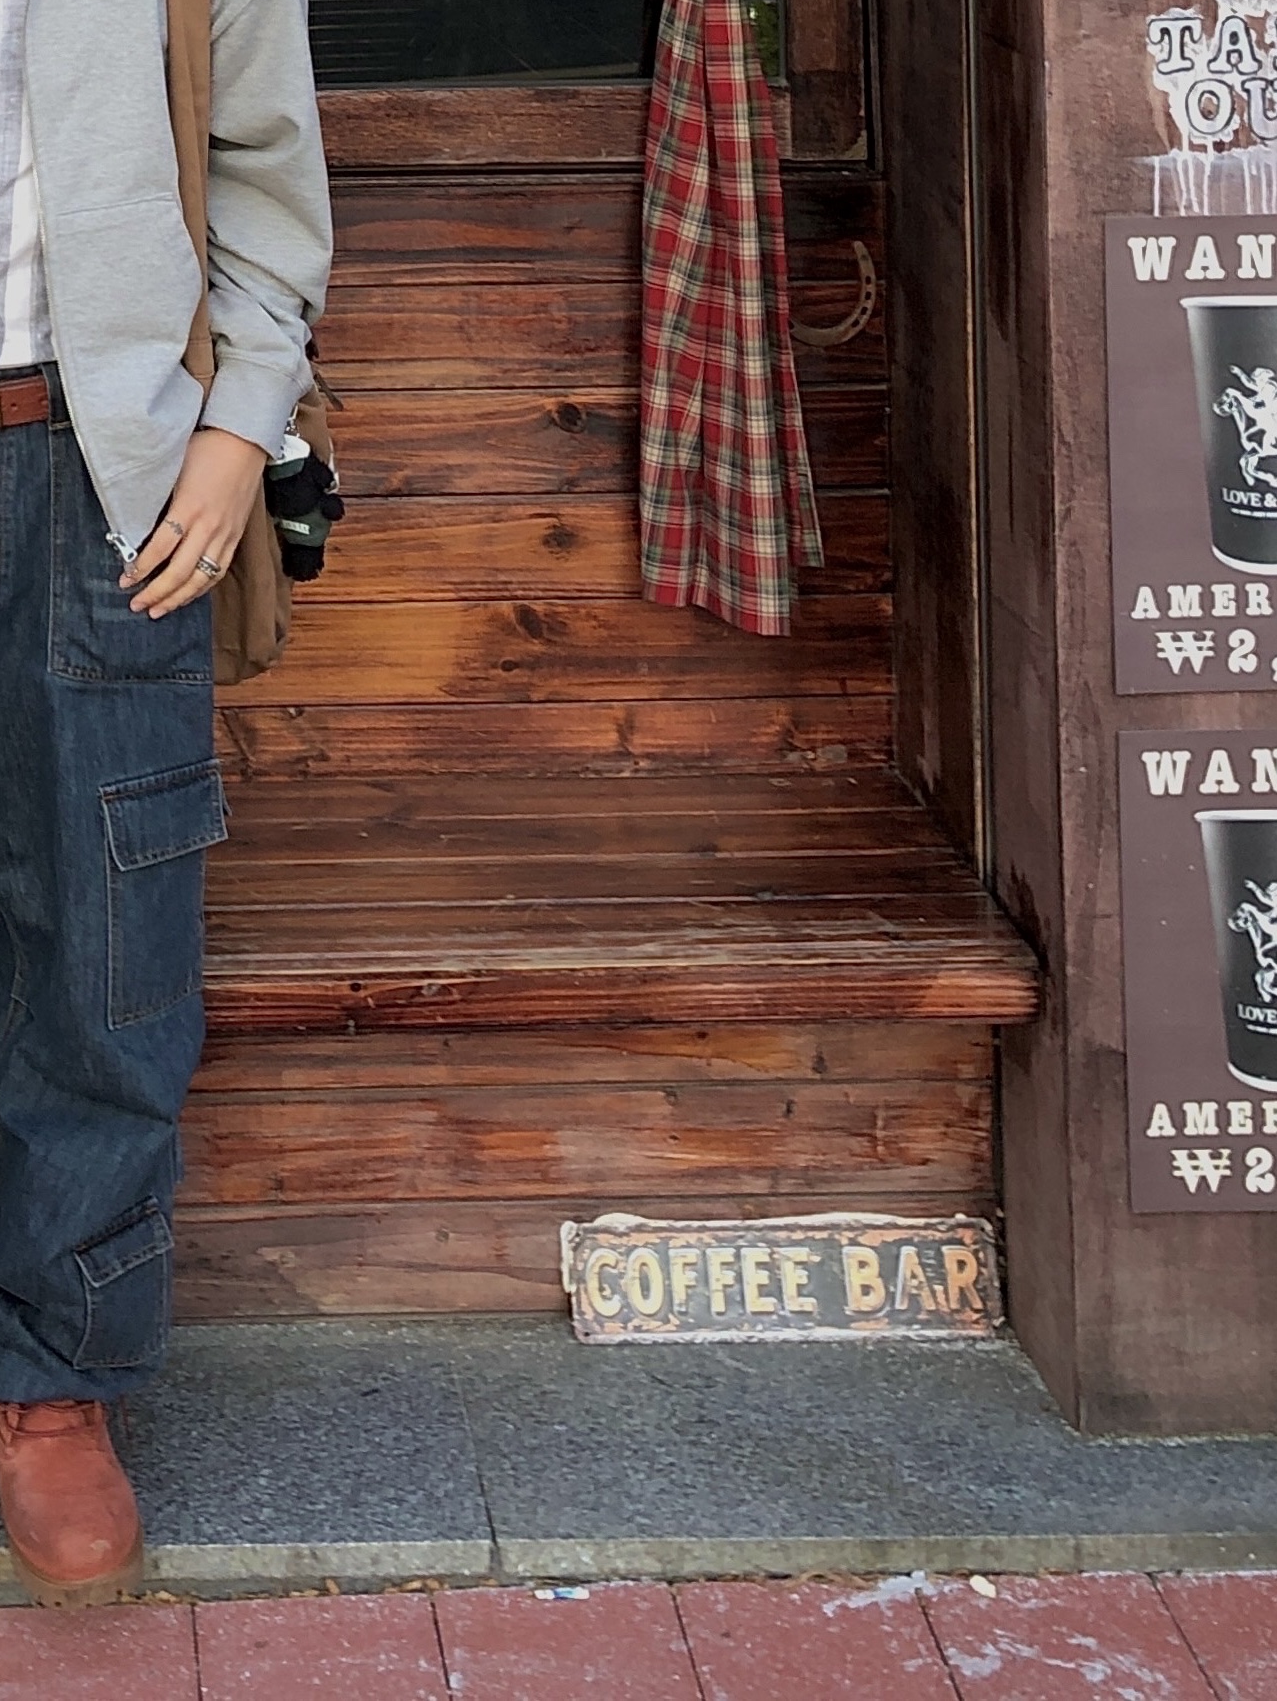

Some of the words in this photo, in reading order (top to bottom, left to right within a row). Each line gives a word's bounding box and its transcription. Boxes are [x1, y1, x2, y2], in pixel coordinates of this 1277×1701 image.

[1147, 15, 1277, 76] TA
[1222, 486, 1262, 508] LOVE
[1237, 1003, 1277, 1024] LOVE
[585, 1247, 818, 1318] COFFEE
[843, 1244, 986, 1315] BAR
